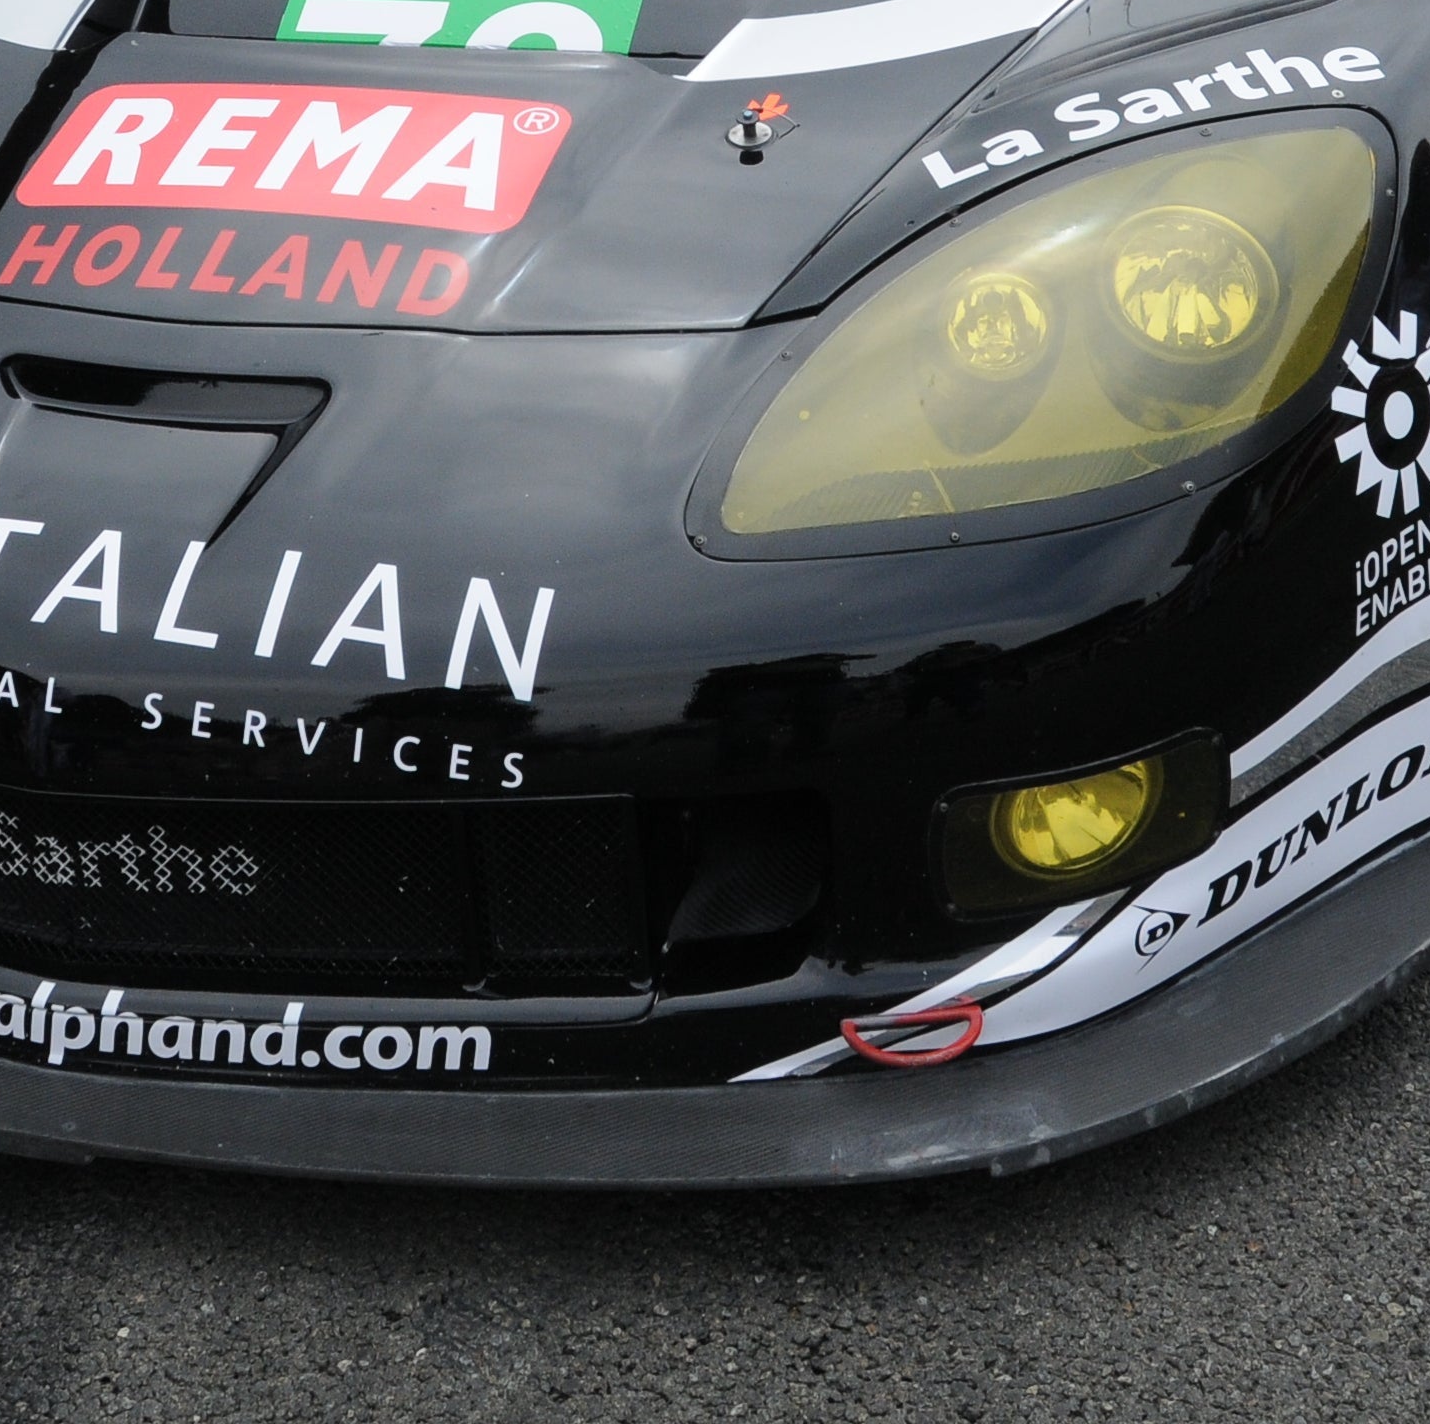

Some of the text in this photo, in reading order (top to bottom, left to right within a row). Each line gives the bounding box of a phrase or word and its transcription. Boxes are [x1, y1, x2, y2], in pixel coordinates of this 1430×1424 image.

[52, 96, 523, 212] REMA
[921, 42, 1387, 189] La Sarthe
[141, 691, 527, 790] SERVICES
